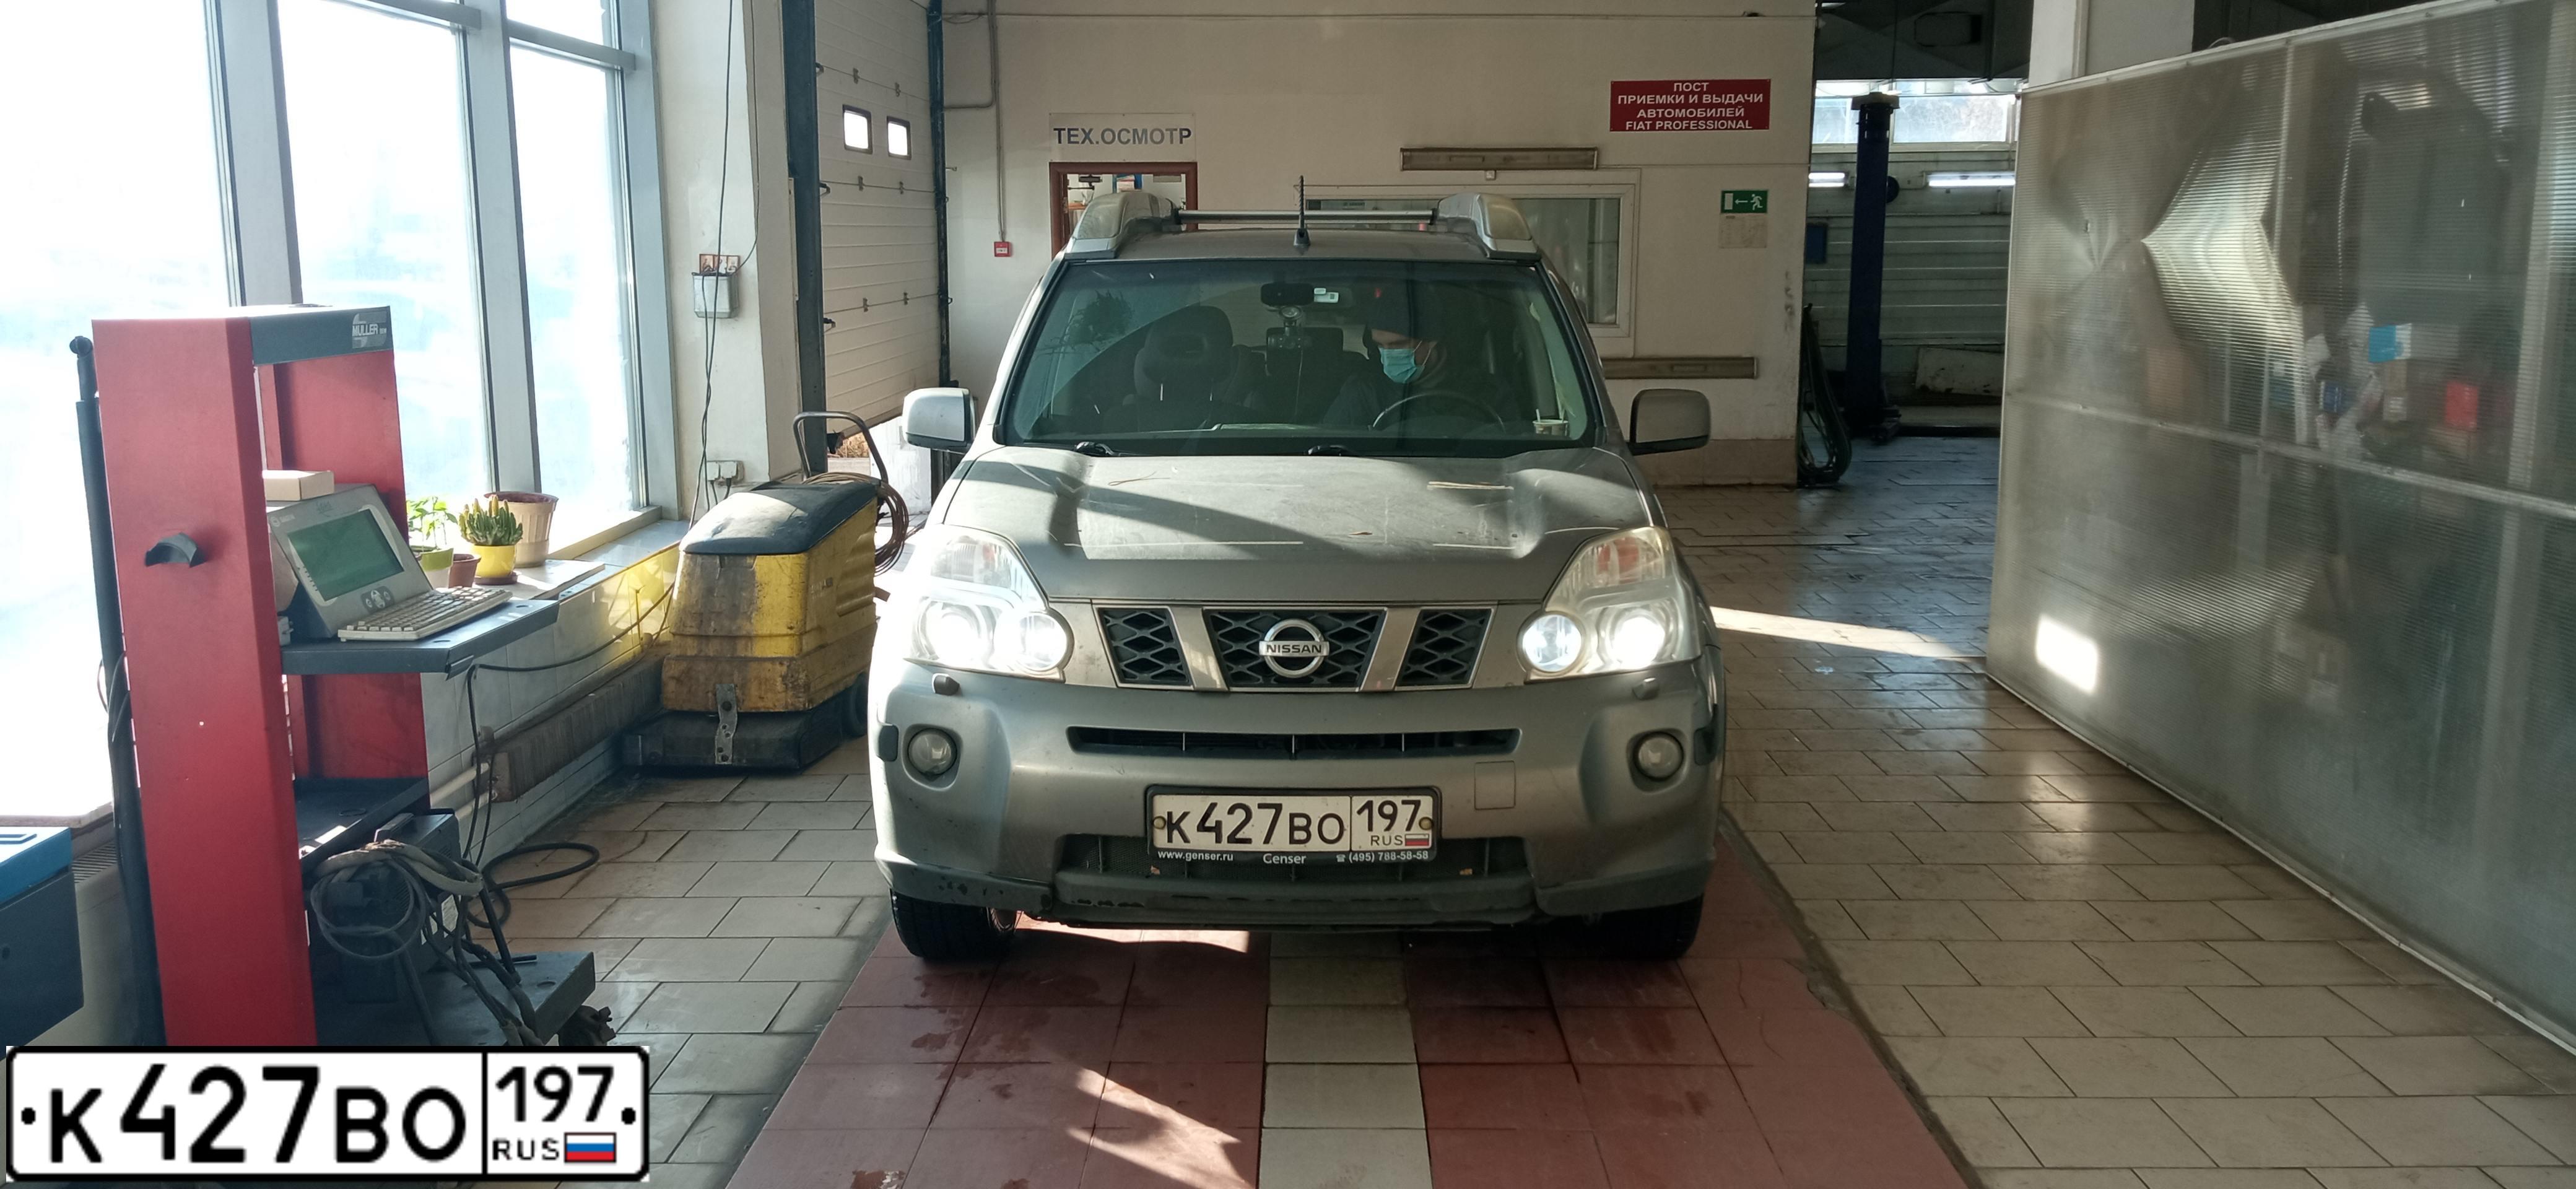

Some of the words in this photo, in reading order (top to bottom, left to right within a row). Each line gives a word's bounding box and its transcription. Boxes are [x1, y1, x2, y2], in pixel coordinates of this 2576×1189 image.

[1674, 82, 1710, 92] ПОСТ
[1617, 95, 1685, 105] ПРИЕМКИ
[1689, 94, 1699, 104] И
[1702, 94, 1764, 105] ВЫДАЧИ
[1637, 106, 1744, 118] АВТОМОБИЛЕЙ
[1625, 121, 1653, 131] FIAT
[1655, 120, 1753, 130] PROFESSIONAL
[1053, 128, 1192, 145] ТЕХ.ОСМОТР
[1266, 644, 1322, 653] NISSAN
[1356, 799, 1422, 832] 197
[1370, 834, 1404, 846] RUS
[1158, 851, 1234, 862] www.genser.ru
[1349, 851, 1375, 863] (495)
